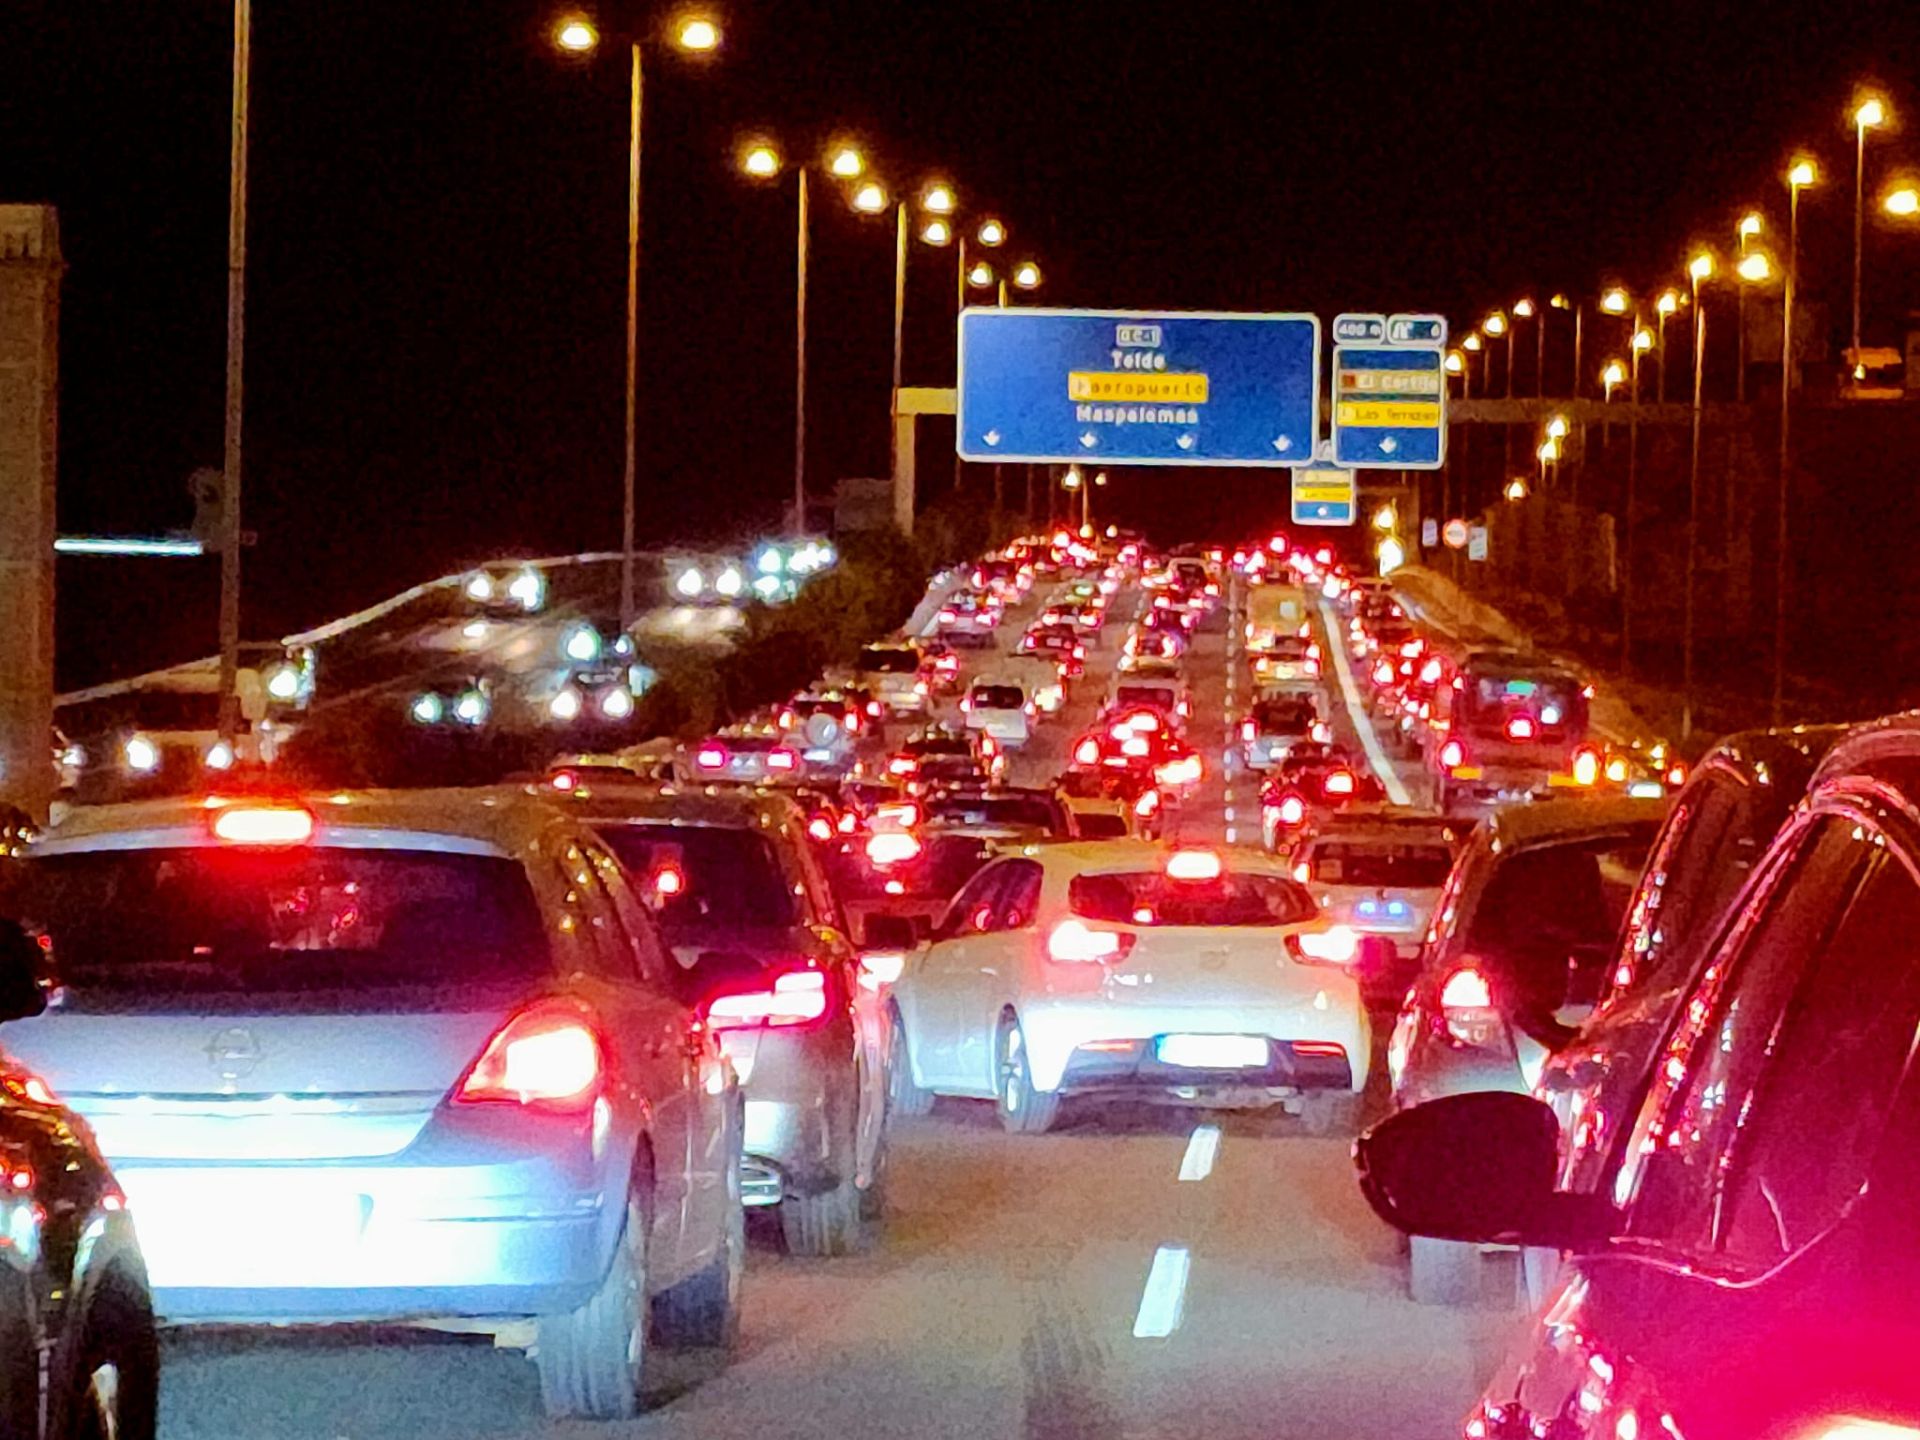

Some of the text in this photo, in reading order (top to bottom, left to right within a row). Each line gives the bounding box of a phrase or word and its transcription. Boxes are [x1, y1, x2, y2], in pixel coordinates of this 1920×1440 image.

[1111, 350, 1166, 368] Telde
[1090, 382, 1204, 396] aeropuerto
[1076, 404, 1197, 426] Maspalomas
